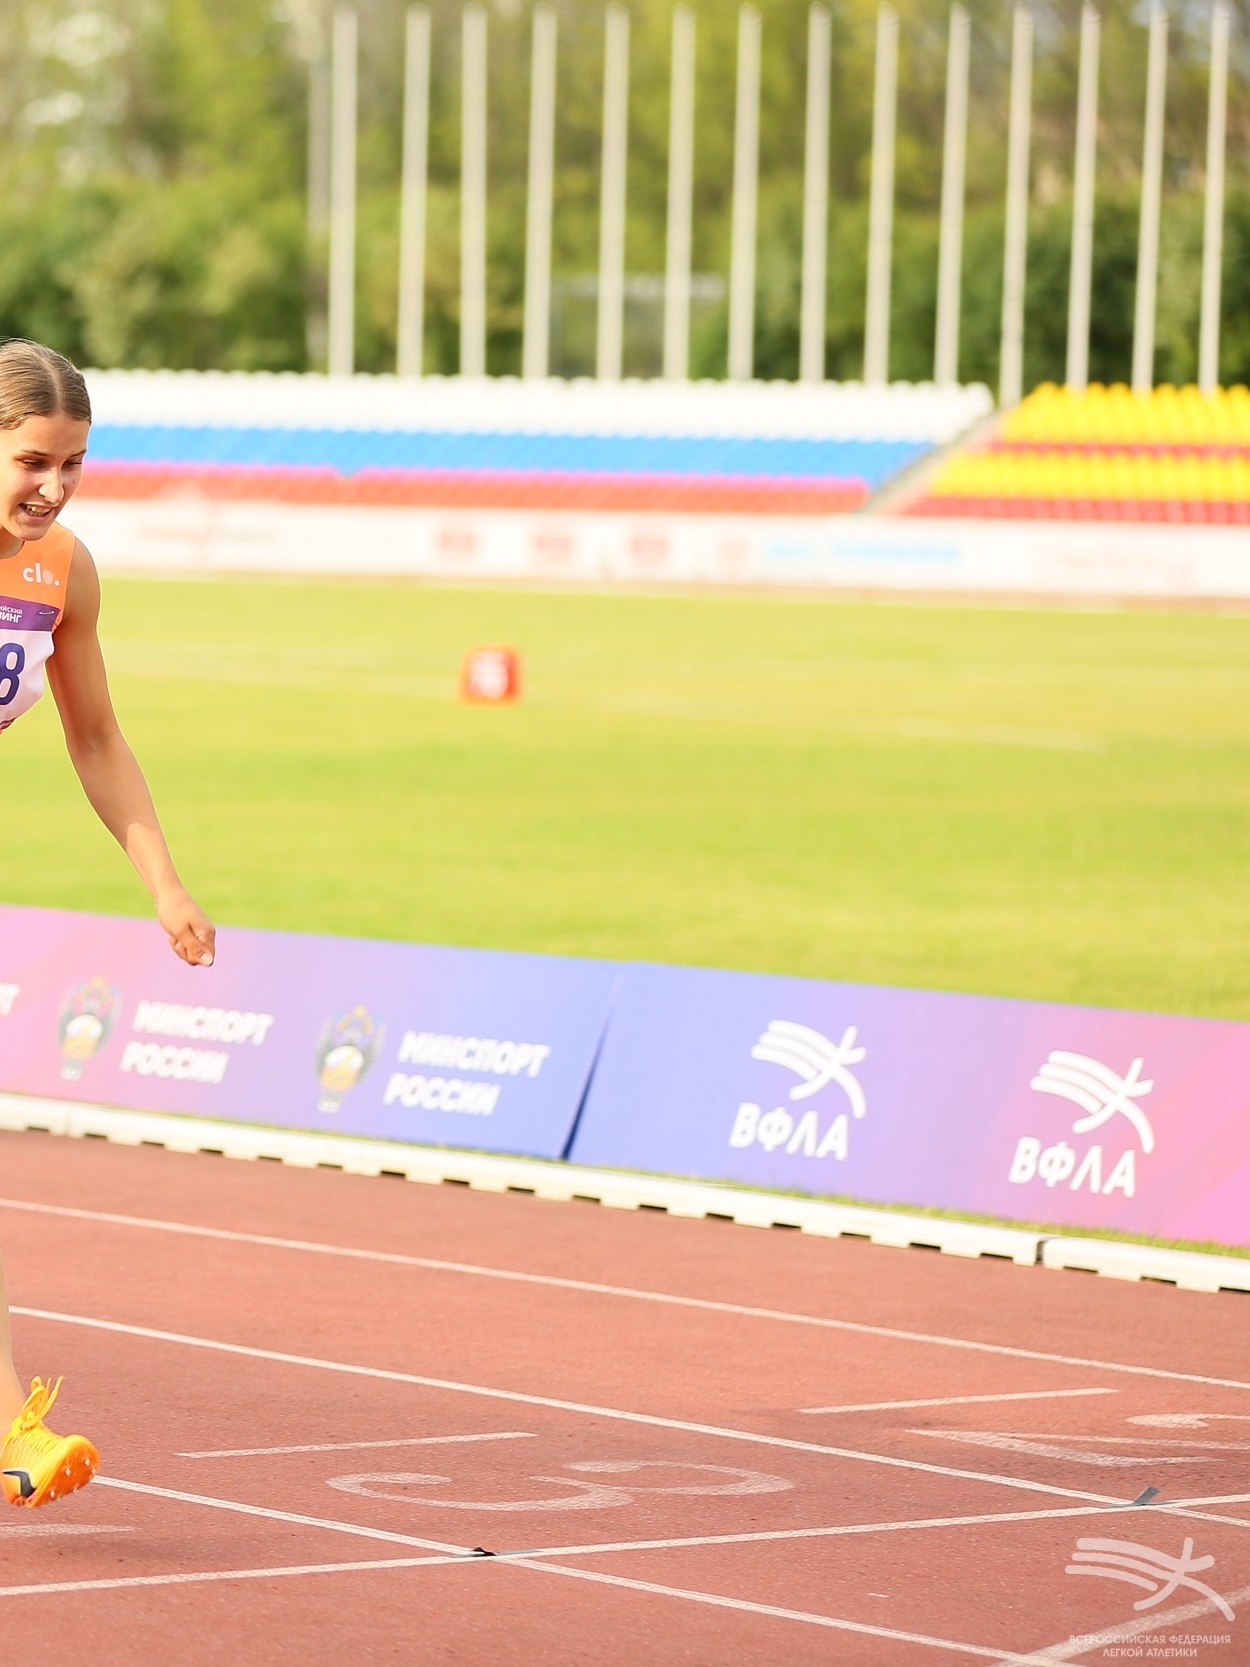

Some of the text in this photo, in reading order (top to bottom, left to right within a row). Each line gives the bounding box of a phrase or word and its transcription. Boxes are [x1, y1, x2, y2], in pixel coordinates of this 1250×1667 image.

[132, 999, 275, 1047] МИНСПОРТ
[120, 1040, 230, 1085] РОССИИ
[397, 1029, 552, 1078] МИНСПОРТ
[382, 1072, 502, 1118] РОССИИ
[729, 1101, 851, 1162] ВФЛА
[1008, 1136, 1136, 1198] ВФЛА
